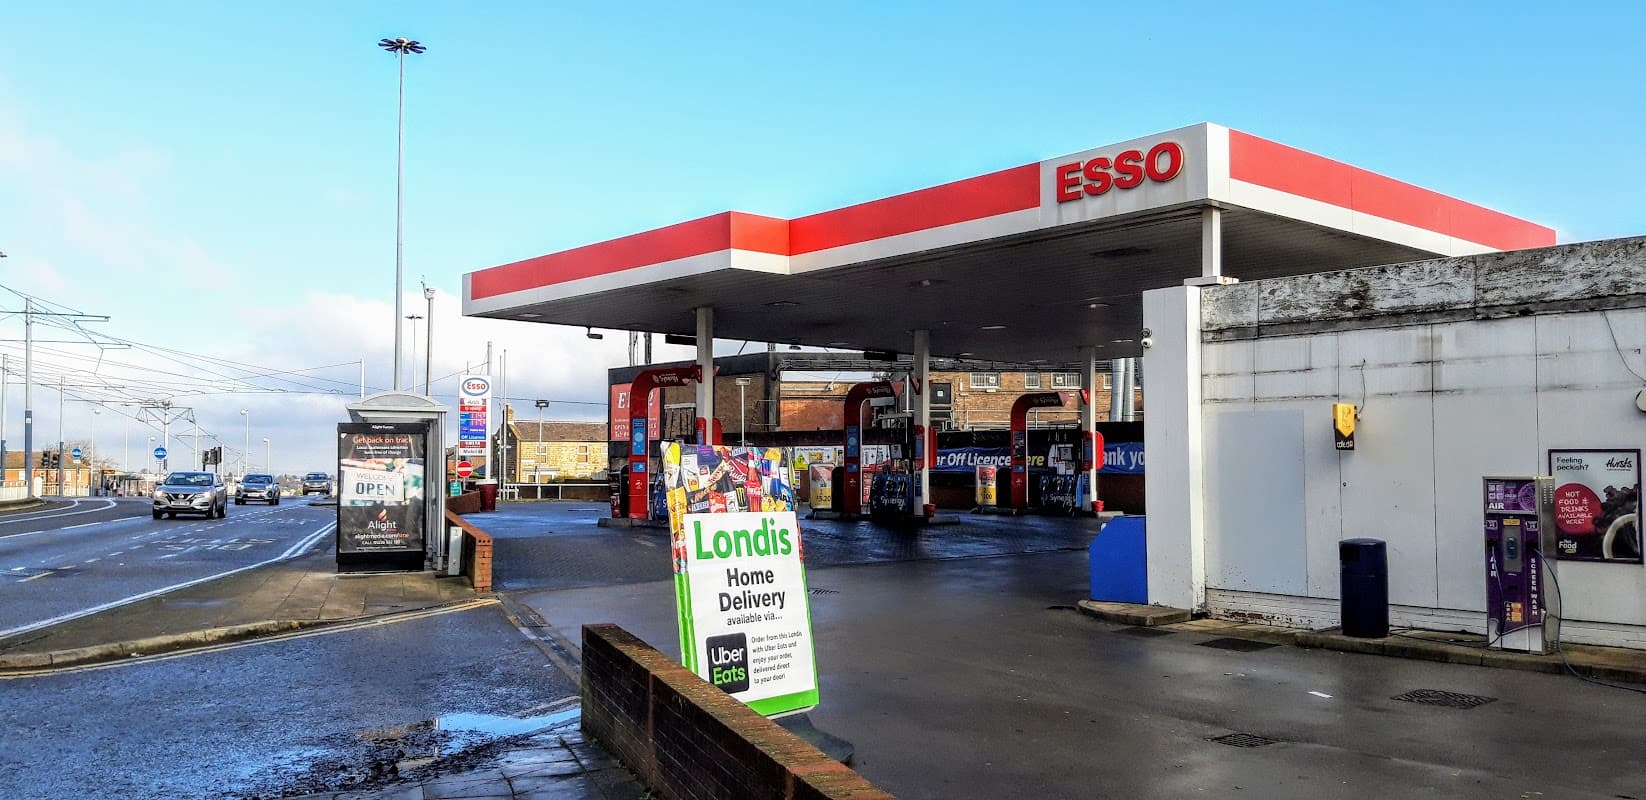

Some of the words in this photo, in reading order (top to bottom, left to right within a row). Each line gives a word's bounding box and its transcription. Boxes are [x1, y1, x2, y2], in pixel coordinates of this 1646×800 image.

[1056, 141, 1184, 203] ESSO
[466, 382, 486, 390] Esso
[352, 436, 366, 444] Get
[367, 436, 384, 444] back
[395, 436, 412, 444] track
[947, 452, 966, 466] Off
[967, 452, 1012, 466] Licence
[1027, 455, 1045, 466] ere
[1104, 446, 1126, 466] ank
[1129, 451, 1144, 470] yo
[1556, 456, 1582, 464] Feeling
[355, 482, 395, 496] OPEN
[1488, 502, 1504, 510] AIR
[1557, 512, 1592, 520] AVAILABLE
[367, 520, 398, 531] Alight
[693, 517, 792, 560] Londis
[1558, 541, 1577, 549] Food
[1489, 555, 1497, 577] AIR
[726, 567, 774, 588] Home
[718, 590, 786, 612] Delivery
[1530, 593, 1538, 616] WASH
[727, 612, 762, 627] available
[751, 636, 765, 644] Order
[766, 634, 778, 642] from
[778, 632, 788, 640] this
[752, 646, 764, 654] with
[764, 644, 776, 652] Uber
[777, 642, 788, 650] Eats
[711, 646, 745, 665] Uber
[767, 655, 778, 664] your
[753, 663, 776, 674] delivered
[776, 662, 790, 670] direct
[713, 665, 746, 686] Eats
[760, 676, 772, 684] your
